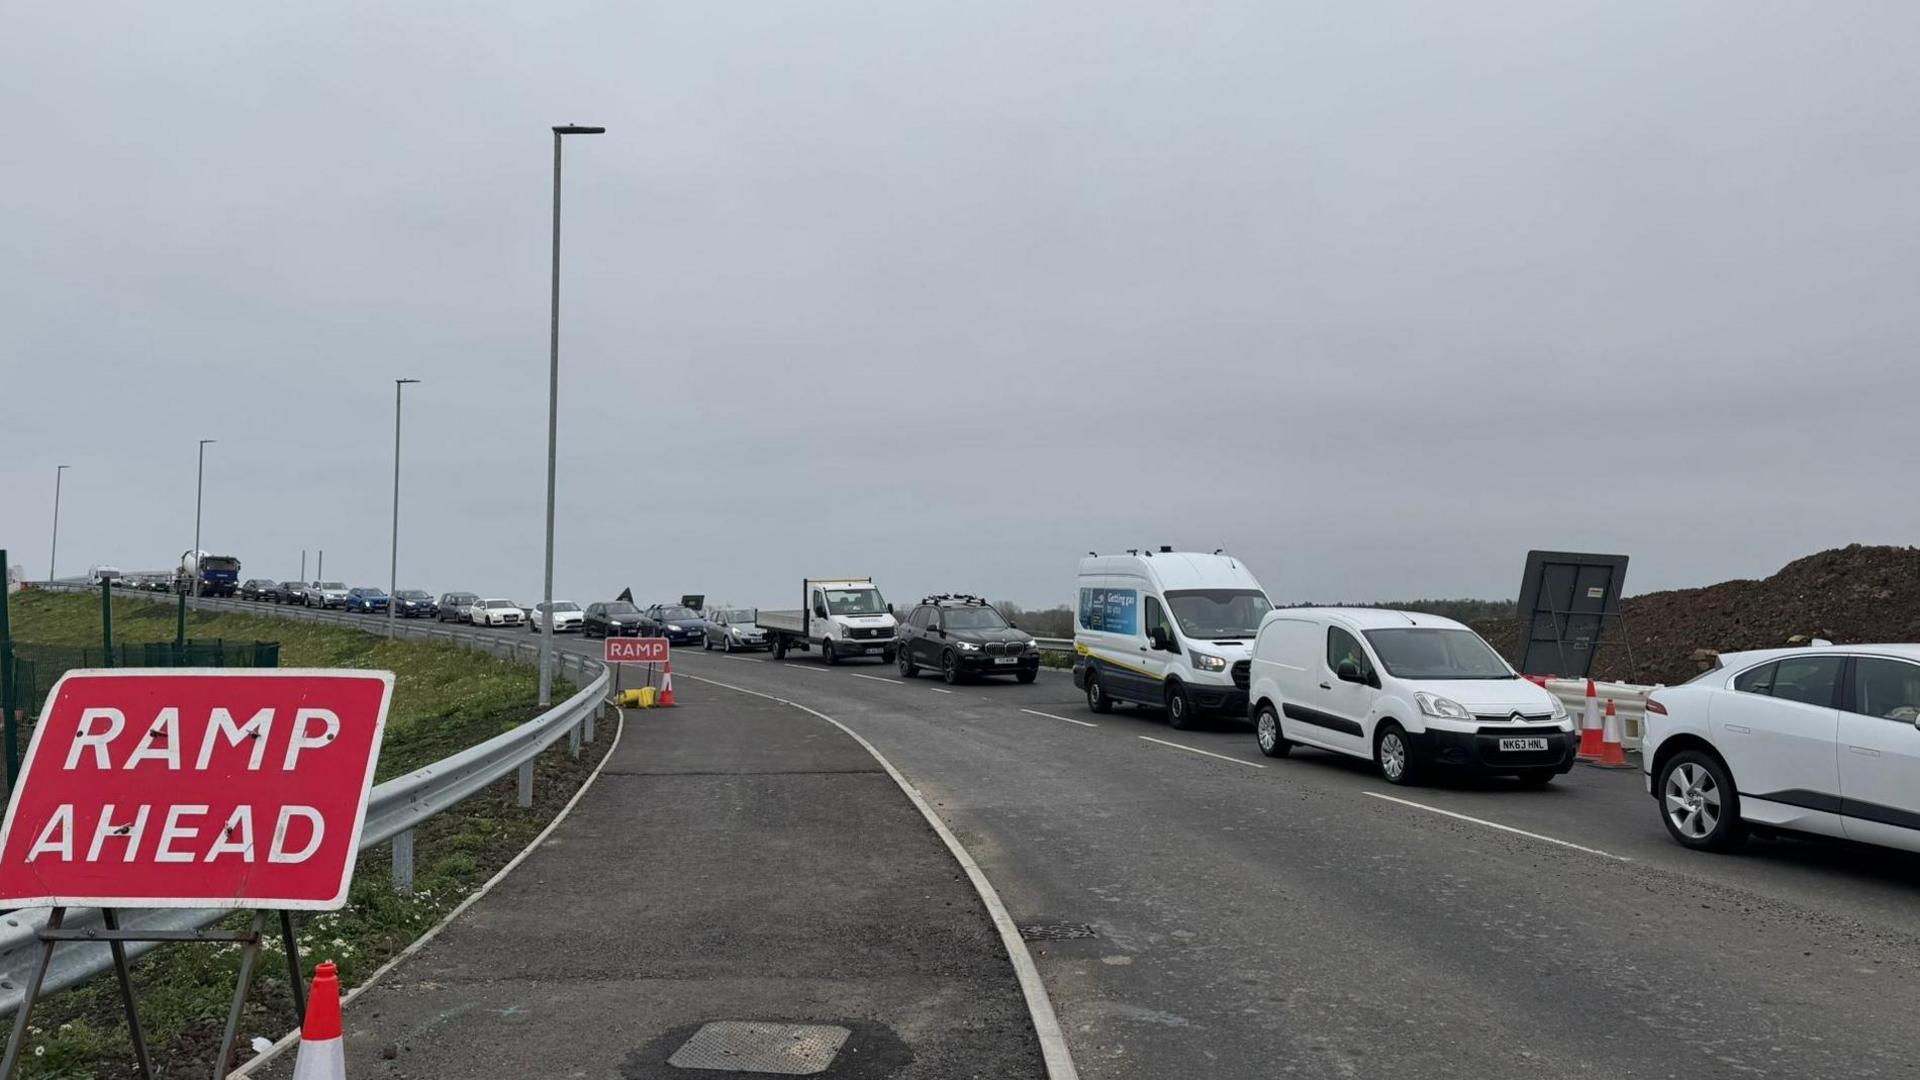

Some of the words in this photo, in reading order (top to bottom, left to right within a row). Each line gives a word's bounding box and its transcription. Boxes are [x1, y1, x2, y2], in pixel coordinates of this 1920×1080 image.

[610, 643, 664, 657] RAMP
[63, 707, 340, 771] RAMP
[1503, 739, 1526, 749] NK63
[1528, 739, 1545, 749] HNL
[25, 804, 325, 864] AHEAD
